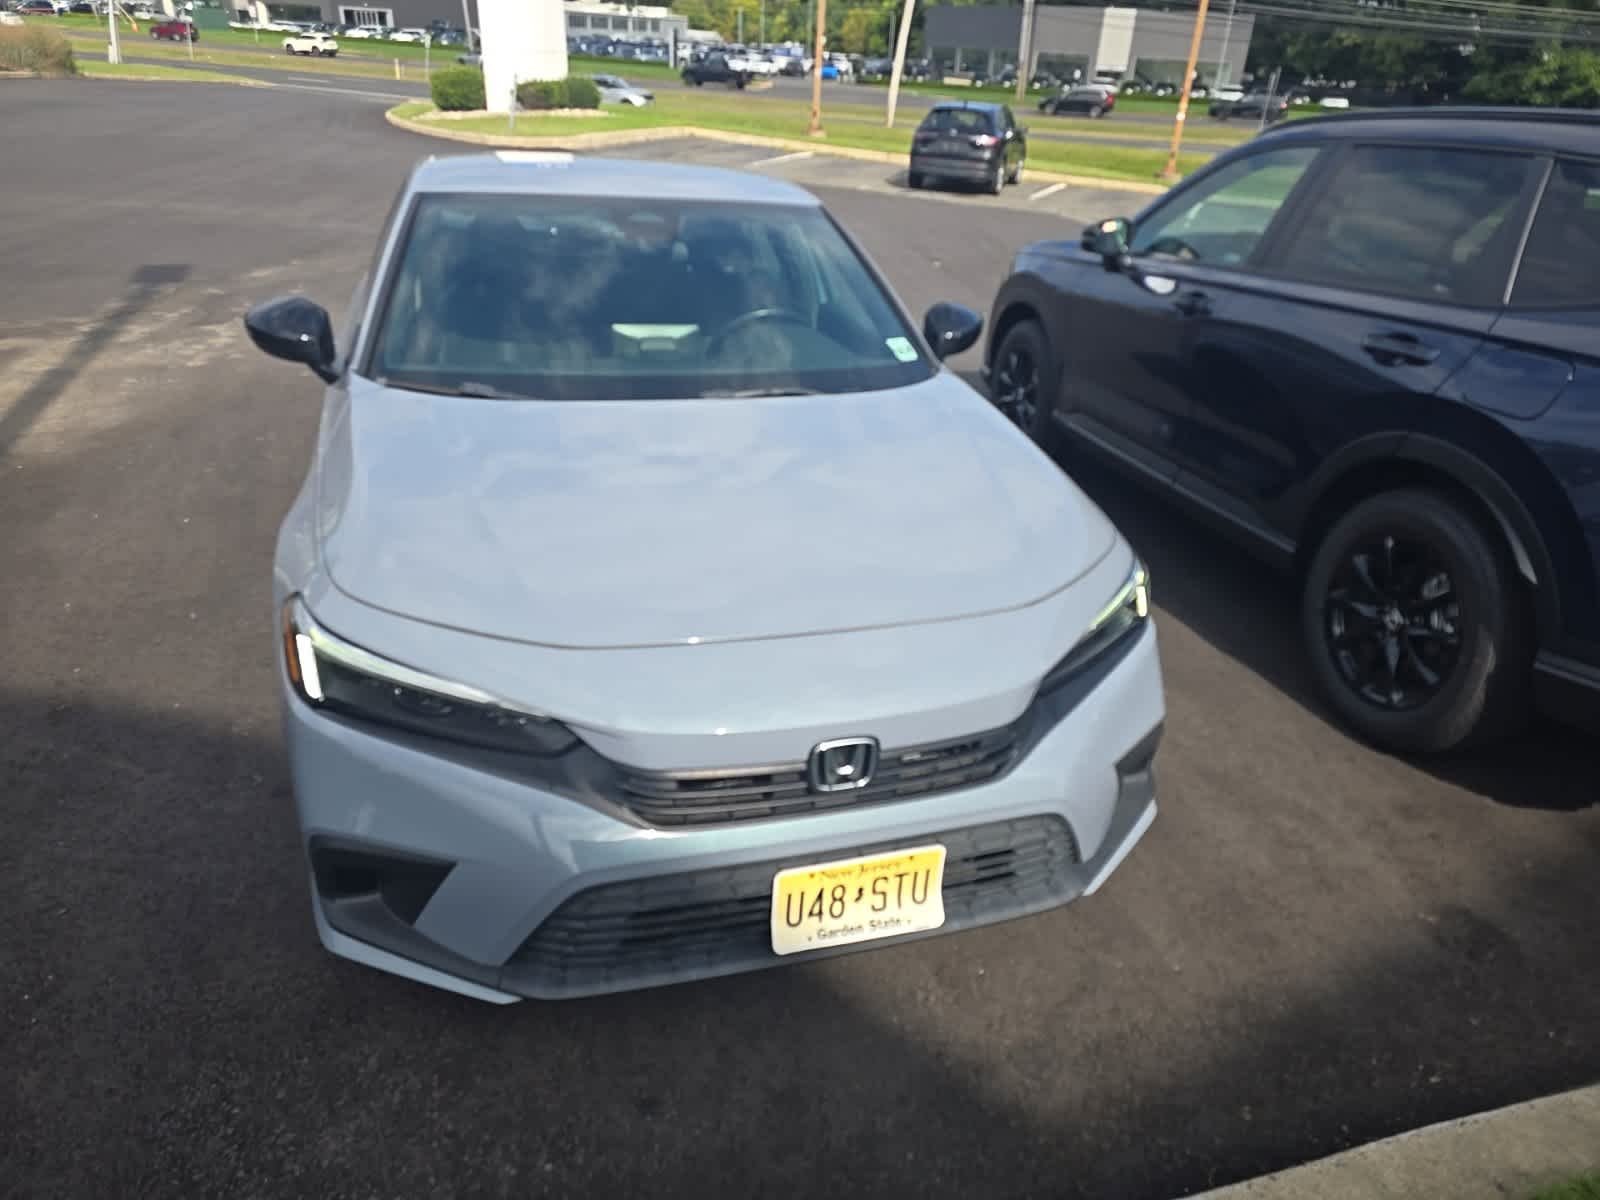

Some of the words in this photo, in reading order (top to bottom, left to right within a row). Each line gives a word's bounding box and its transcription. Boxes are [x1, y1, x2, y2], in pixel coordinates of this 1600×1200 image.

[785, 884, 847, 928] U48
[870, 869, 931, 912] STU
[816, 923, 863, 939] Garden
